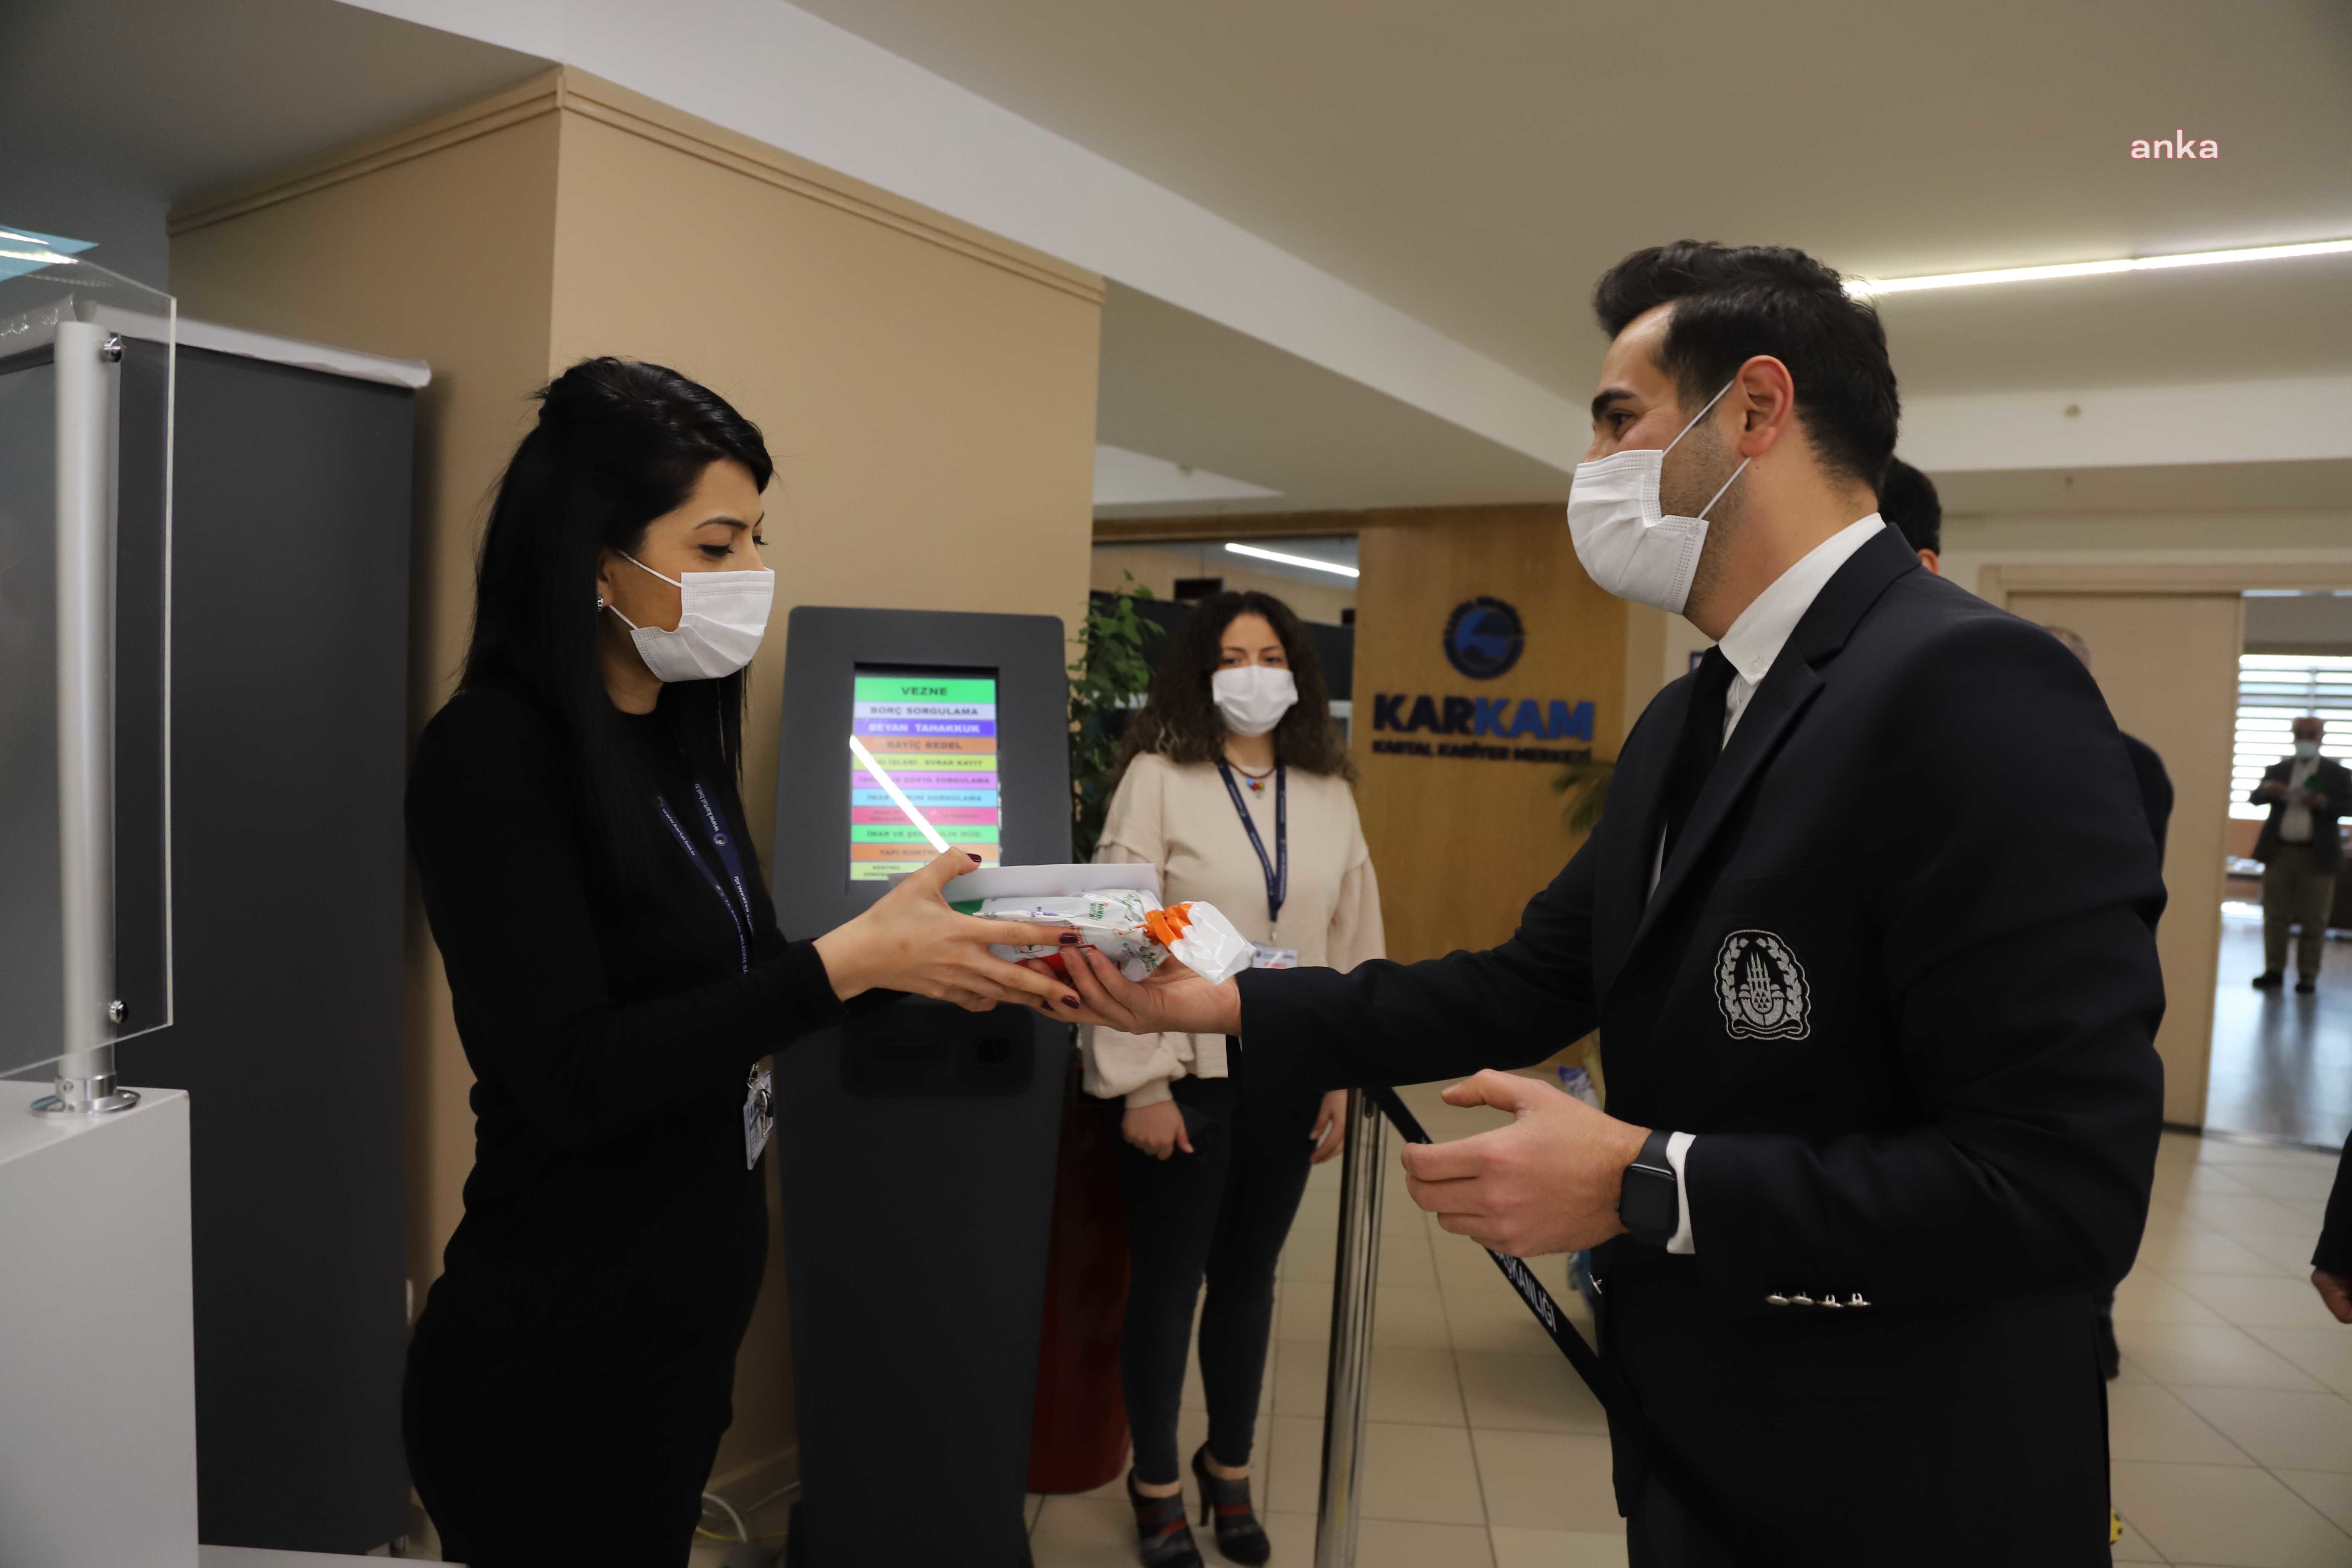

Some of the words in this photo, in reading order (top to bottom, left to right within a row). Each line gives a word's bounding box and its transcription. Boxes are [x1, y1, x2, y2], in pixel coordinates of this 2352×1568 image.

[901, 686, 948, 696] VEZNE
[871, 706, 901, 715] BORÇ
[906, 707, 978, 715] SORGULAMA
[1373, 693, 1595, 742] KARKAM
[868, 723, 908, 732] BEYAN
[915, 724, 980, 733] TAHAKKUK
[887, 741, 922, 750] RAYİÇ
[695, 783, 719, 832] www.kartal.bel.tr
[662, 808, 695, 856] www.kartal.bel.tr
